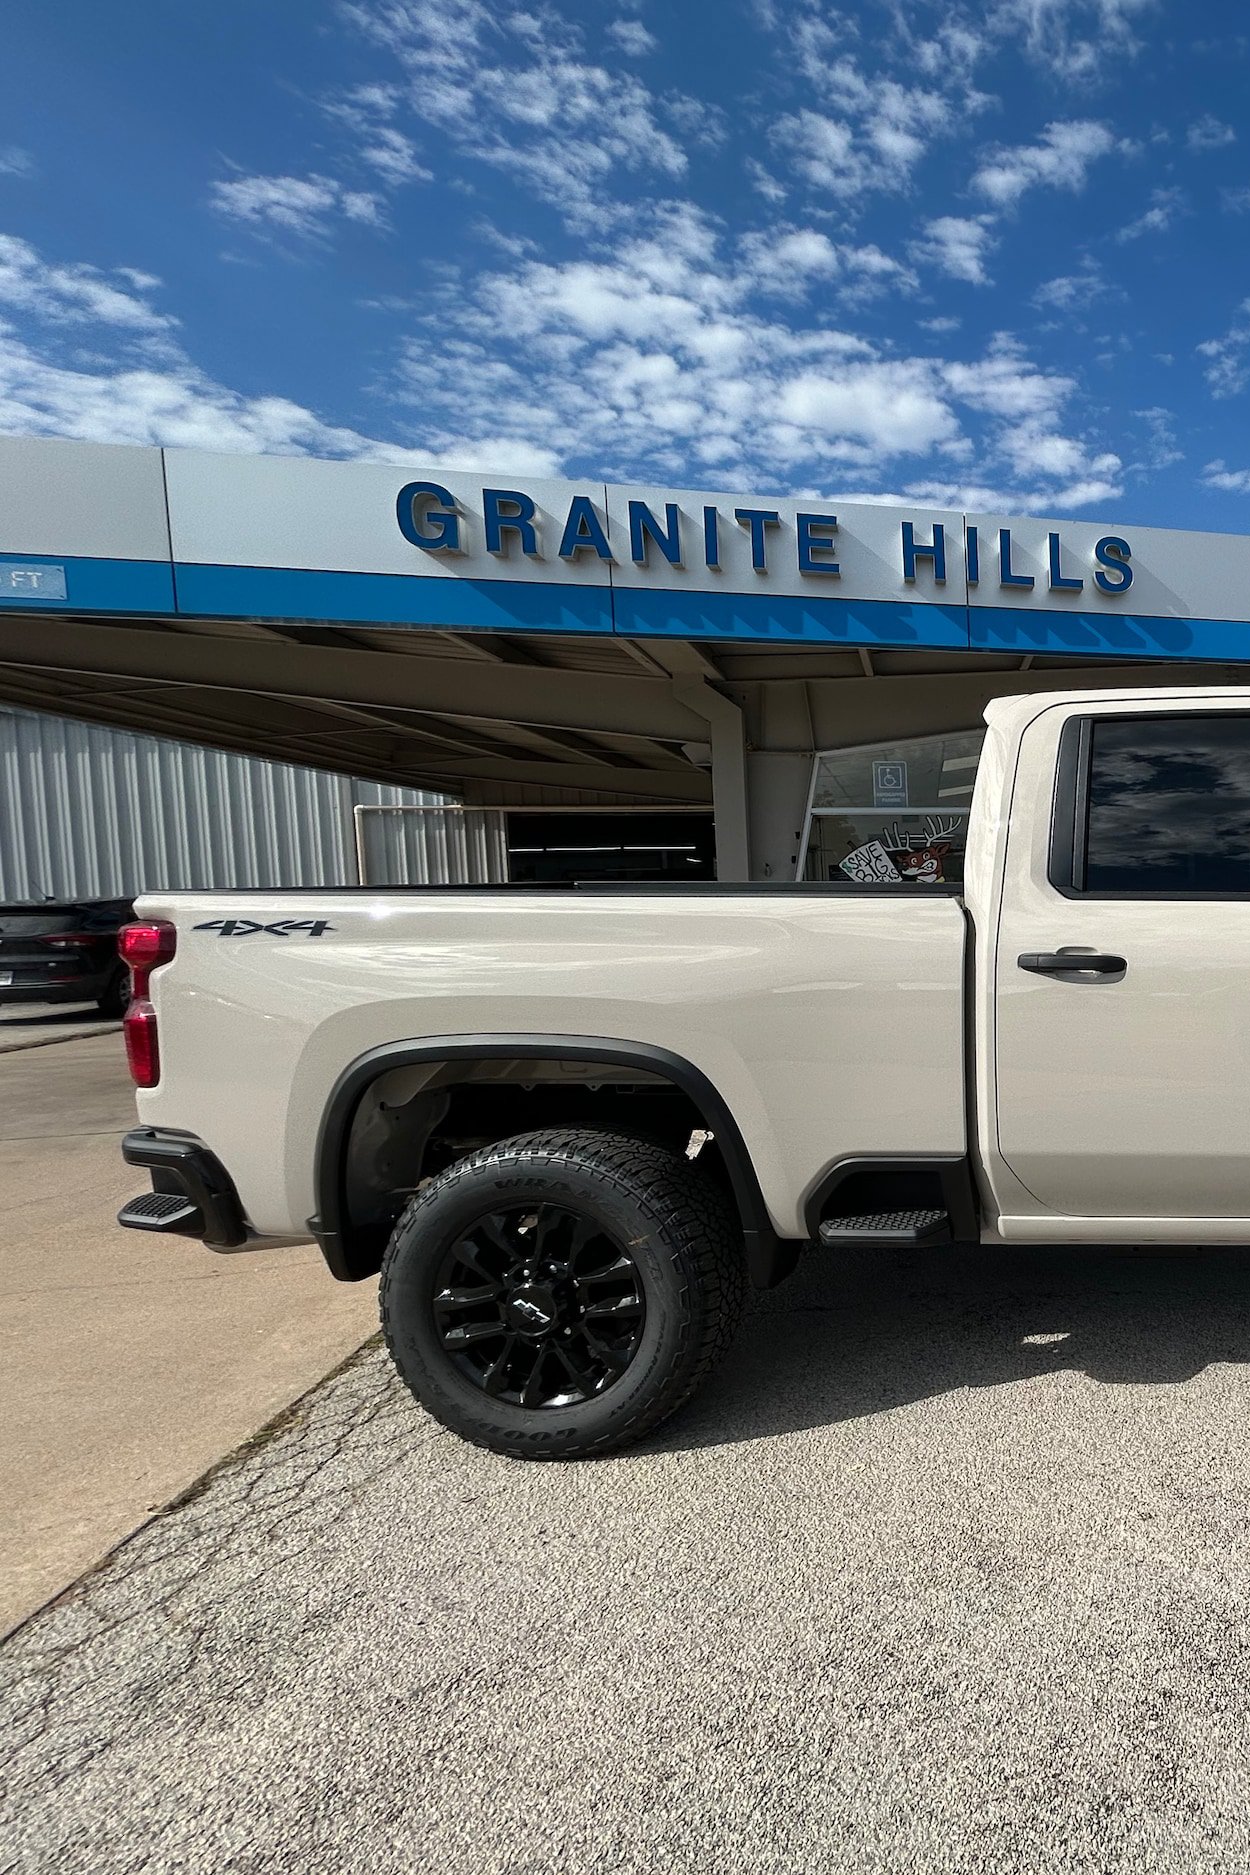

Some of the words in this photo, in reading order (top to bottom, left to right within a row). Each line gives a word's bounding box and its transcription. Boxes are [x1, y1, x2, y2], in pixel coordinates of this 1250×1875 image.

[396, 481, 841, 577] GRANITE
[901, 521, 1135, 596] HILLS
[11, 571, 43, 589] FT
[848, 843, 882, 869] SAVE
[855, 857, 888, 882] BIG
